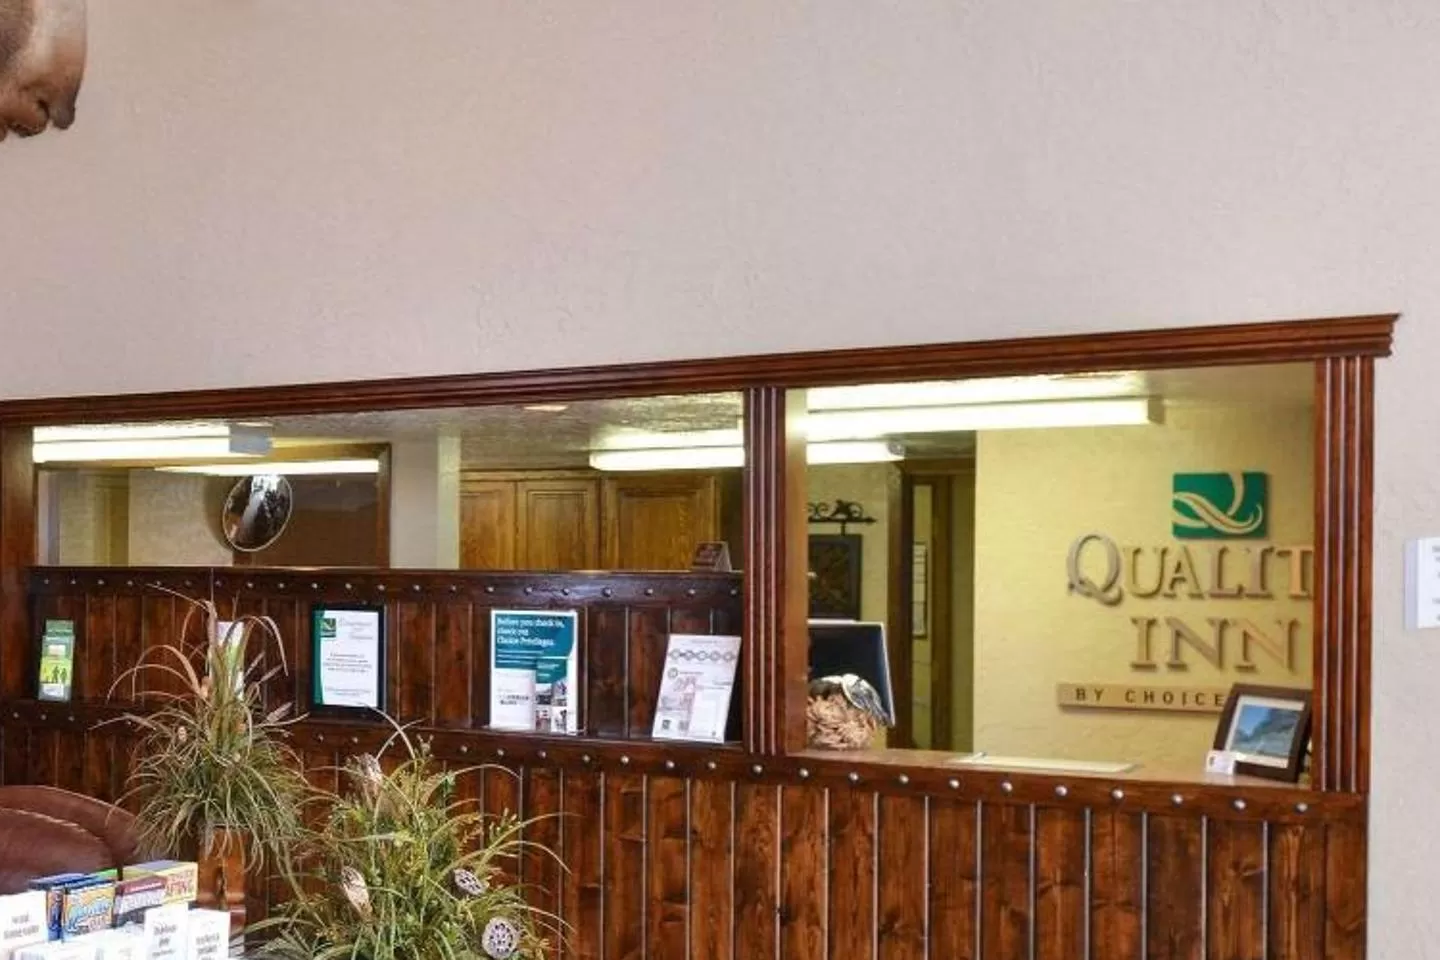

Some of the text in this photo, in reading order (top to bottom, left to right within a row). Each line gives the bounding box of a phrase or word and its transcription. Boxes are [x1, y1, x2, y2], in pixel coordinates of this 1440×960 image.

[1067, 534, 1314, 607] QUALIT
[1129, 616, 1301, 673] INN
[1075, 687, 1224, 708] BY CHOICE
